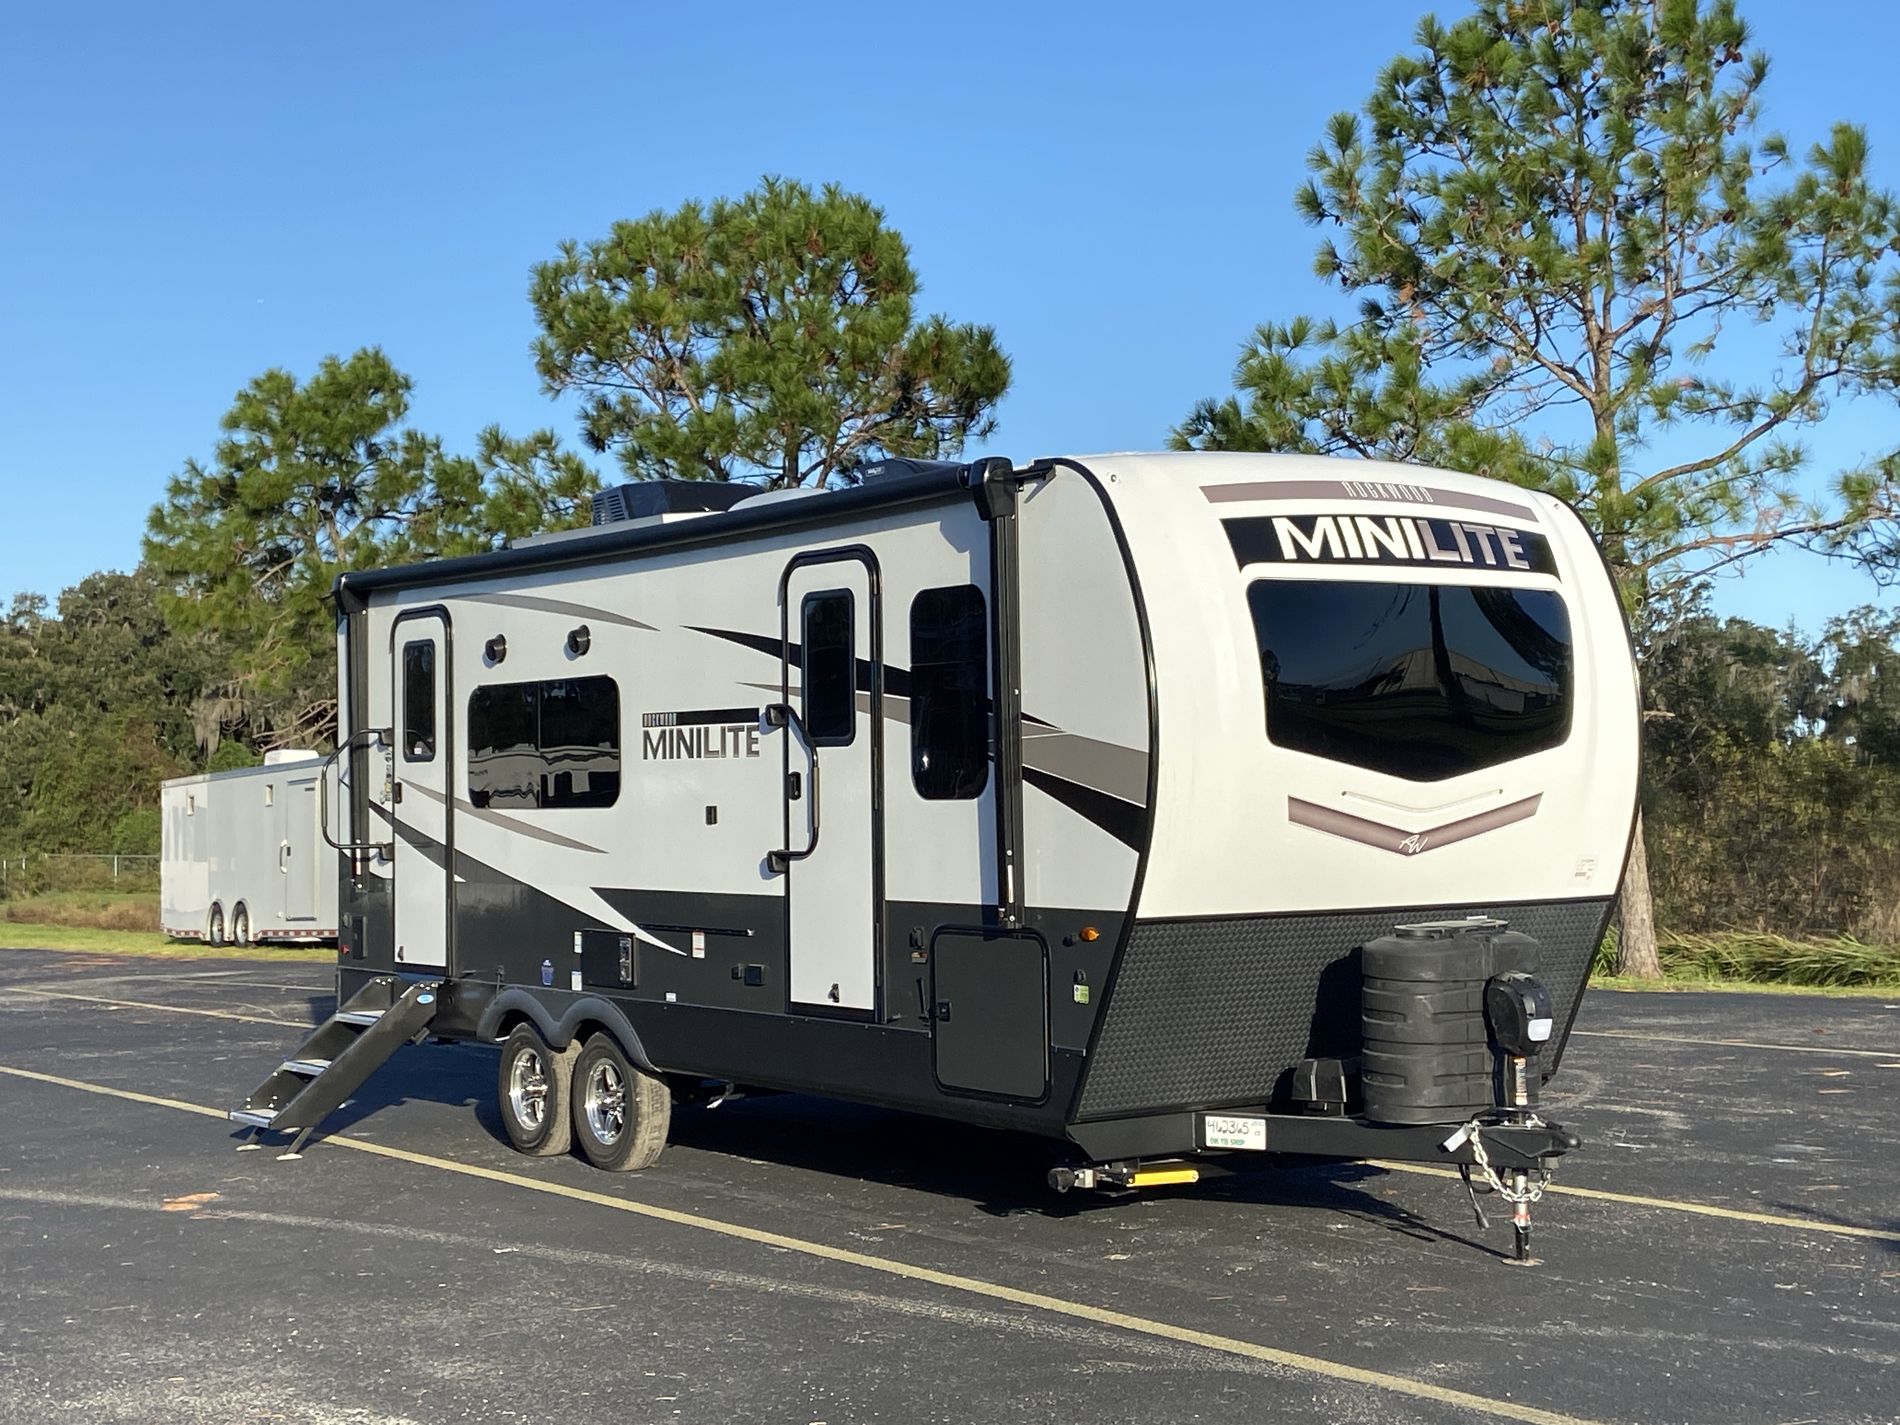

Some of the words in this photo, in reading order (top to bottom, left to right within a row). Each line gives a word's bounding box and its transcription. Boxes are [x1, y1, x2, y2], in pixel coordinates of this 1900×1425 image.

[1341, 481, 1434, 502] ROCKWOOD
[1271, 516, 1530, 569] MINILITE
[643, 725, 760, 760] MINILITE
